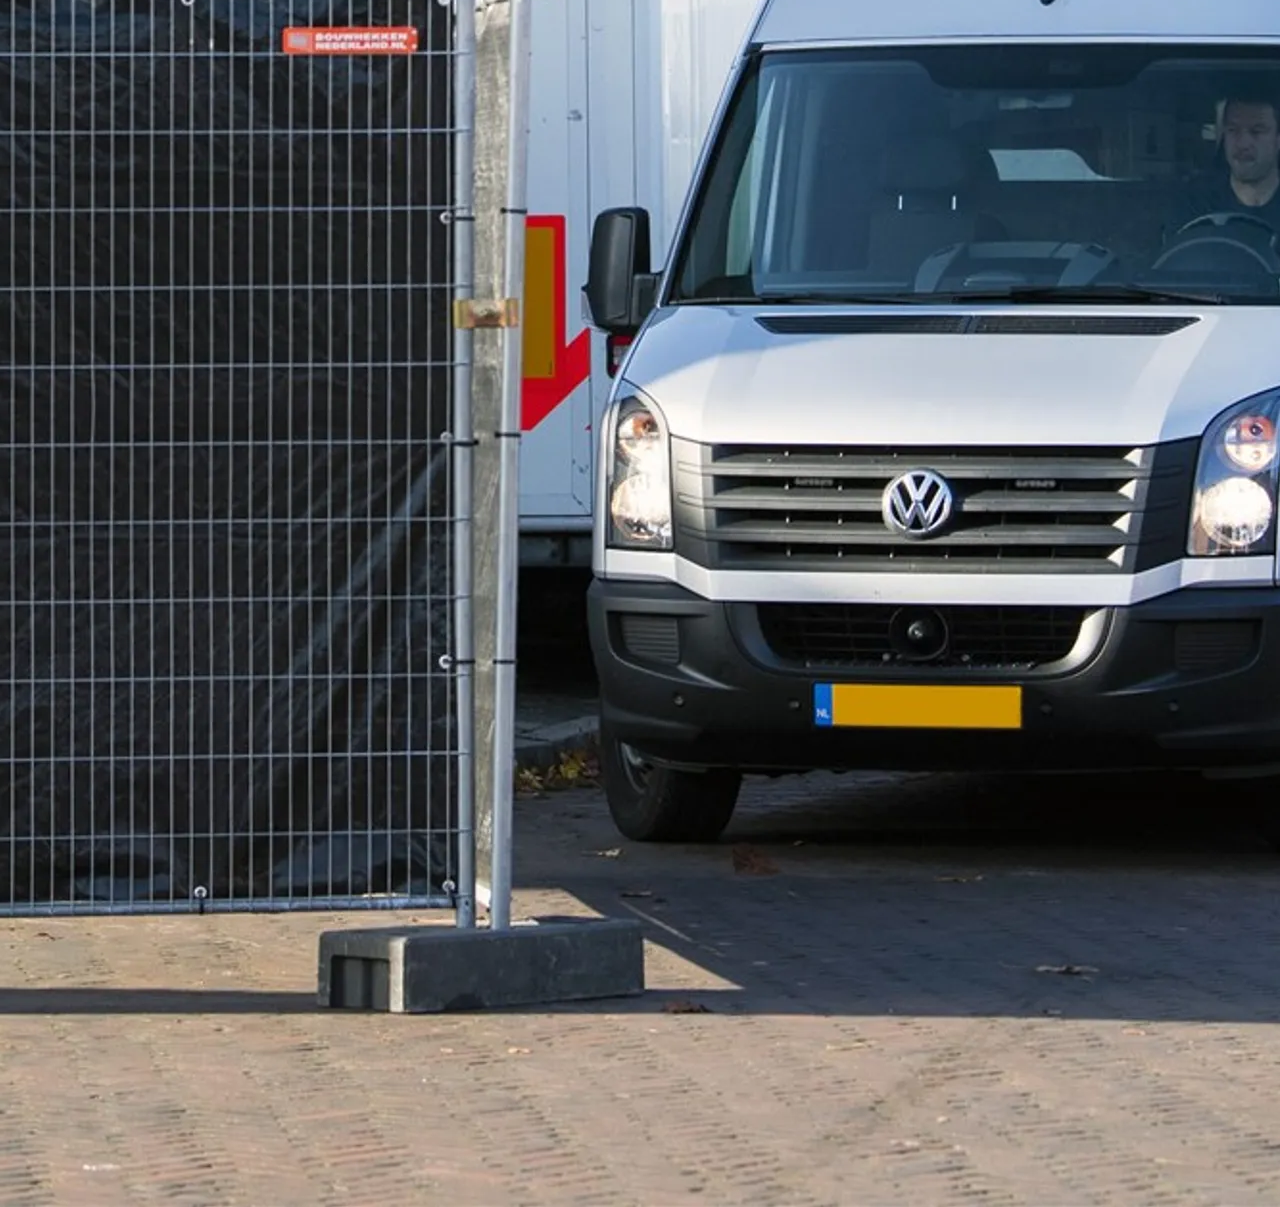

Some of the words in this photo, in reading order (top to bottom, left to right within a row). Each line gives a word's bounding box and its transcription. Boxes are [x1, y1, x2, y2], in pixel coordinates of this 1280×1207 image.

[315, 32, 408, 41] BOUWHEKKEN
[315, 42, 407, 50] NEDERLAND.NL
[816, 708, 829, 719] NL
